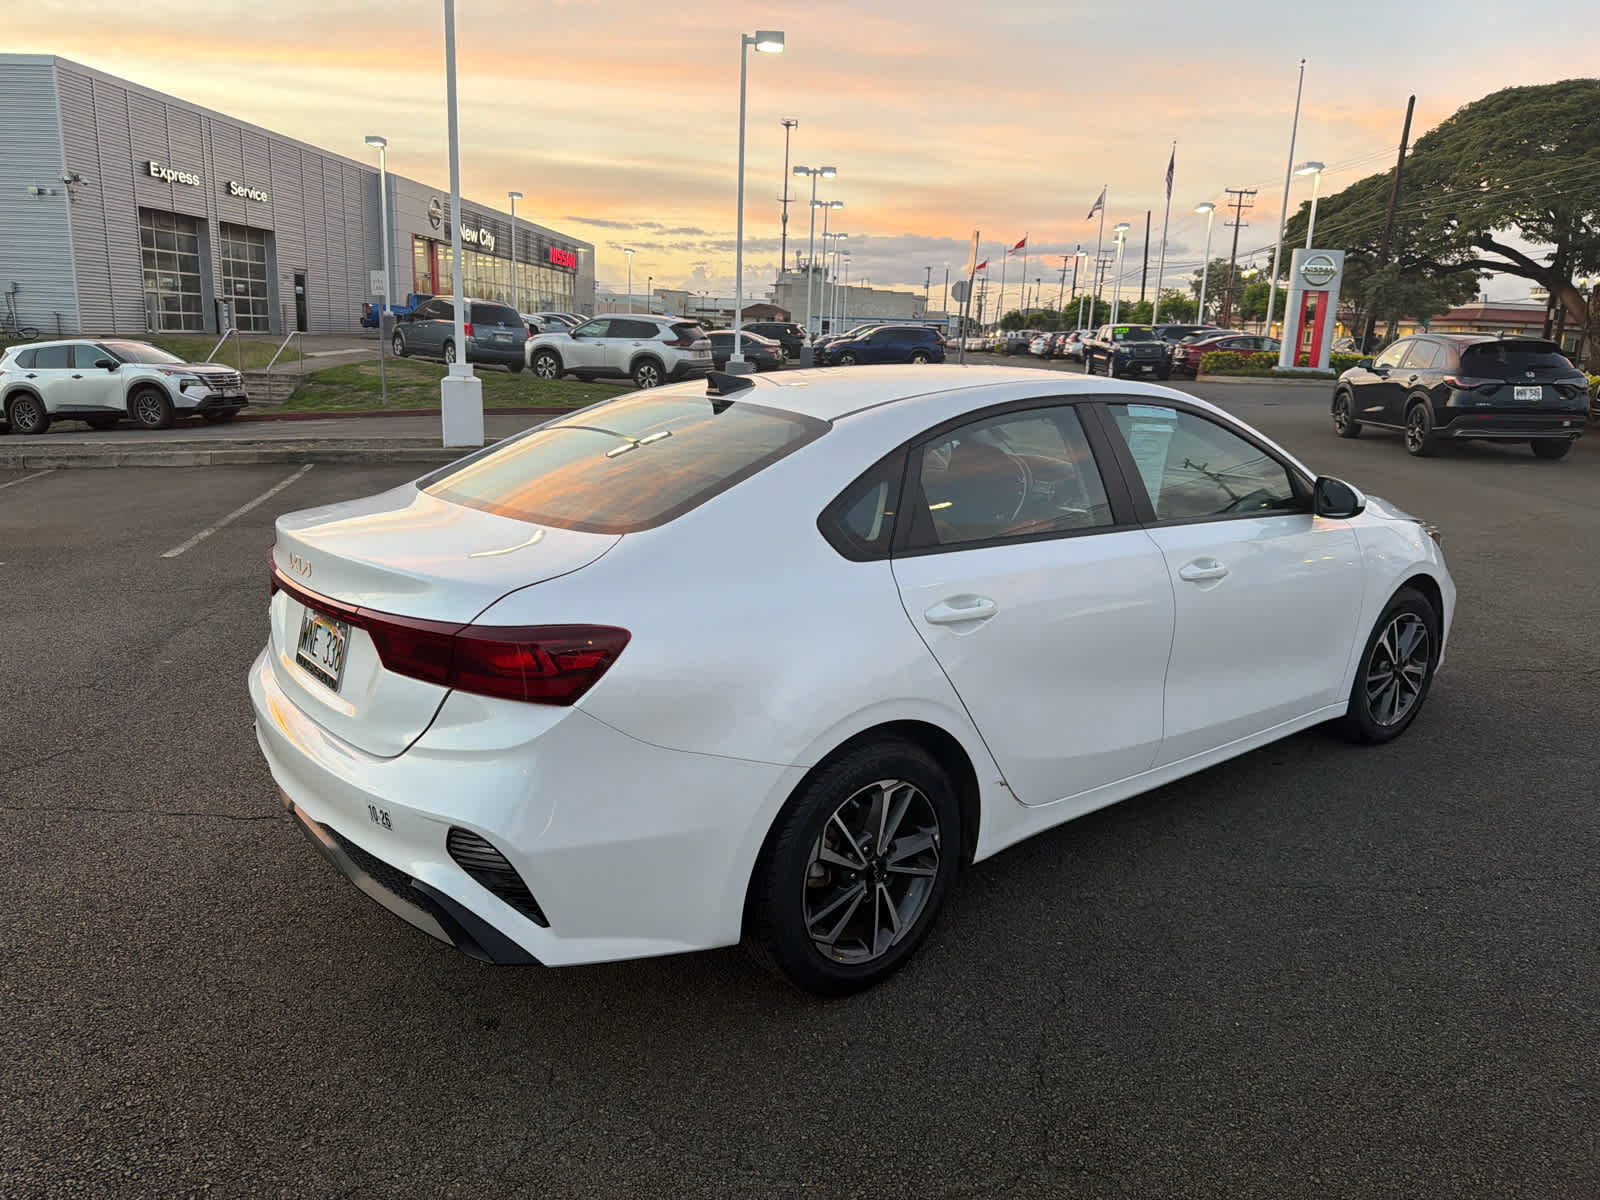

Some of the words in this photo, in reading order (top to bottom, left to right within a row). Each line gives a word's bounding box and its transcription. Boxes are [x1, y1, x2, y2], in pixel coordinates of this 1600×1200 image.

[149, 161, 200, 186] Express
[230, 181, 267, 202] Service
[460, 223, 479, 243] New
[479, 228, 495, 251] City
[550, 247, 576, 269] NISSAN
[1303, 265, 1335, 274] NISSAN
[322, 631, 344, 673] 338
